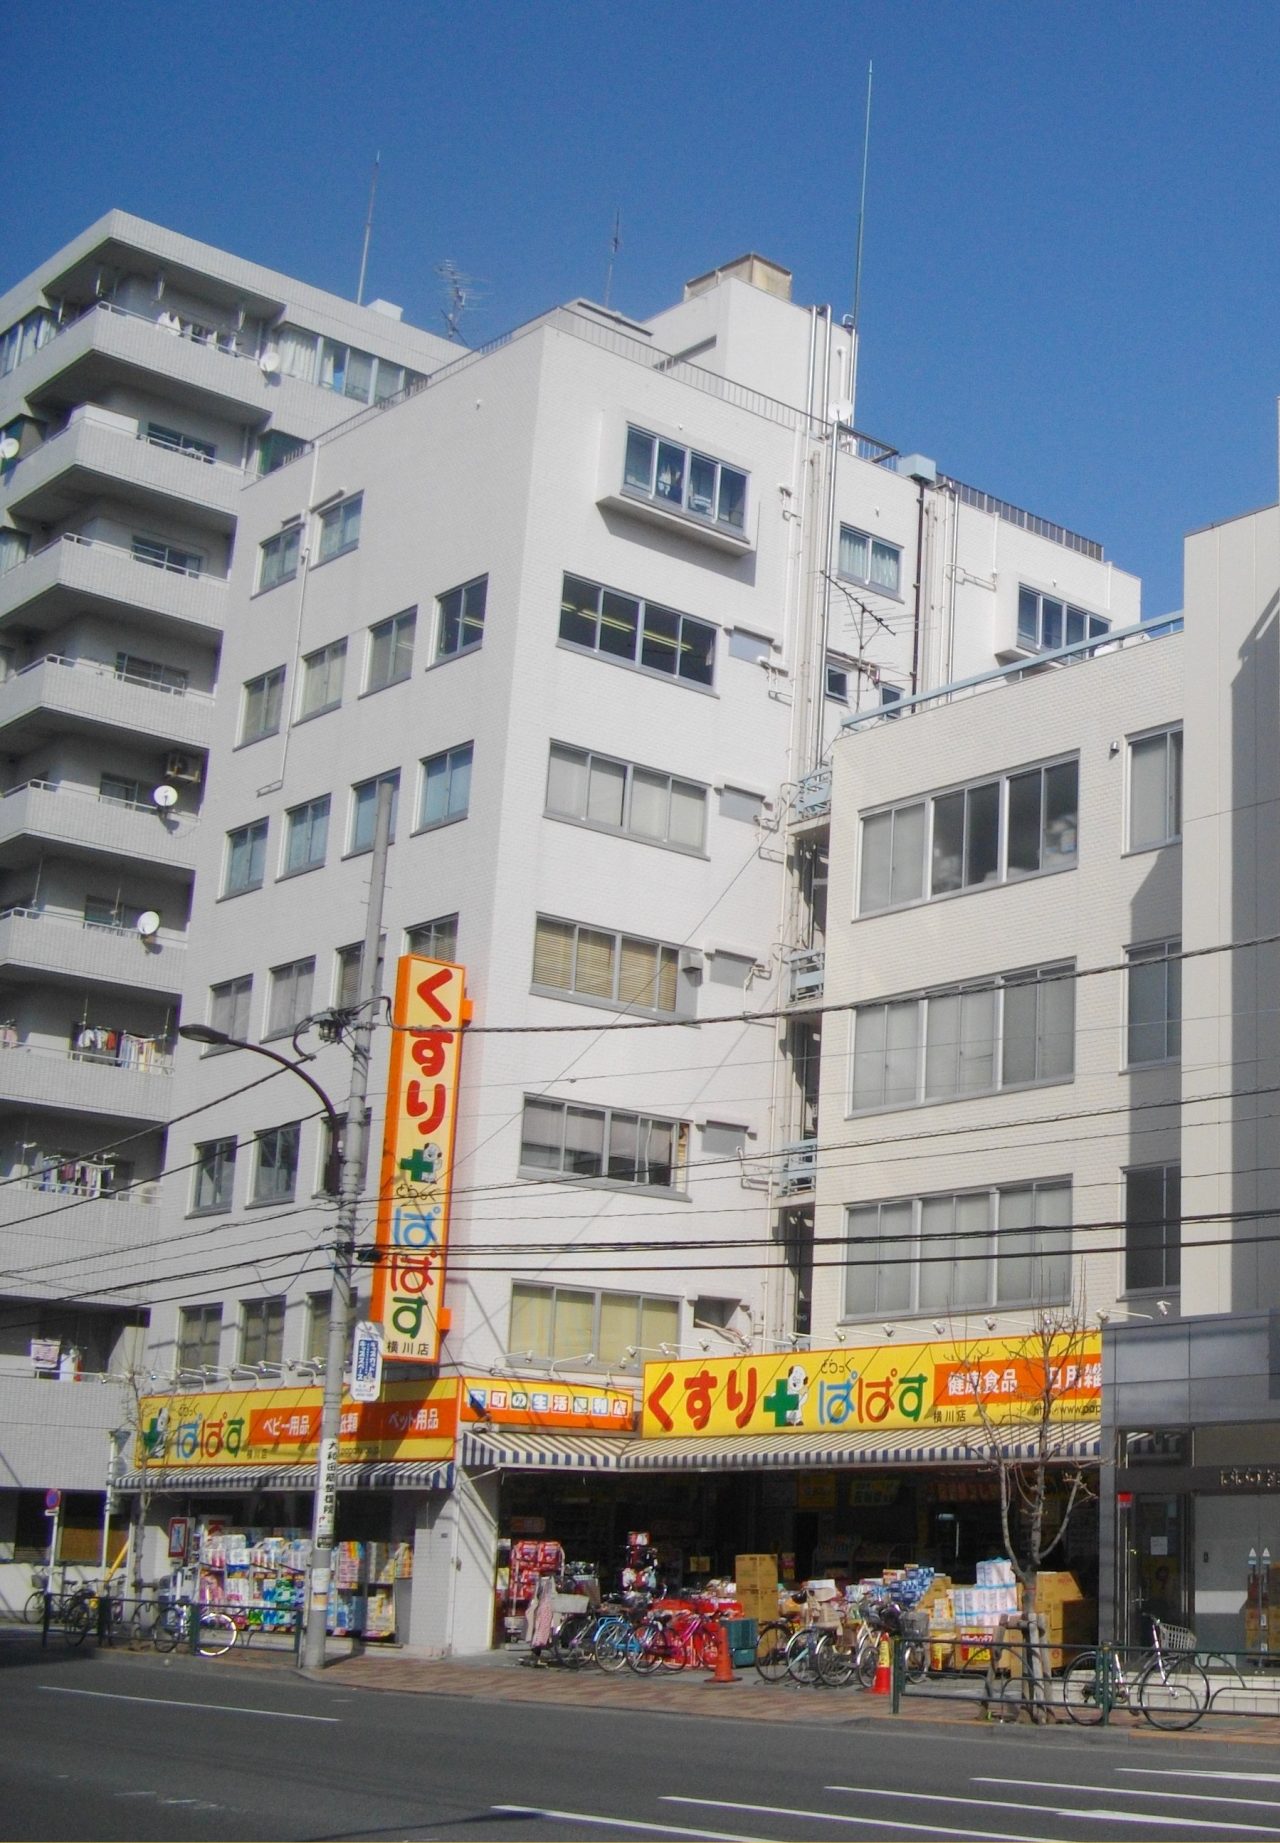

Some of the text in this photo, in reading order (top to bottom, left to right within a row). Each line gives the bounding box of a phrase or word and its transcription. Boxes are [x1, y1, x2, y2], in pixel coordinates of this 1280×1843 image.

[406, 968, 454, 1135] くすり
[391, 1206, 440, 1339] ぱぱす
[387, 1341, 429, 1355] 横川店
[648, 1367, 928, 1431] くすり ぱぱす
[948, 1368, 1018, 1396] 健康食品
[262, 1415, 310, 1436] ベビー用品
[389, 1408, 439, 1432] ペット用品
[934, 1409, 966, 1423] 横川店
[176, 1412, 245, 1459] ぱぱす
